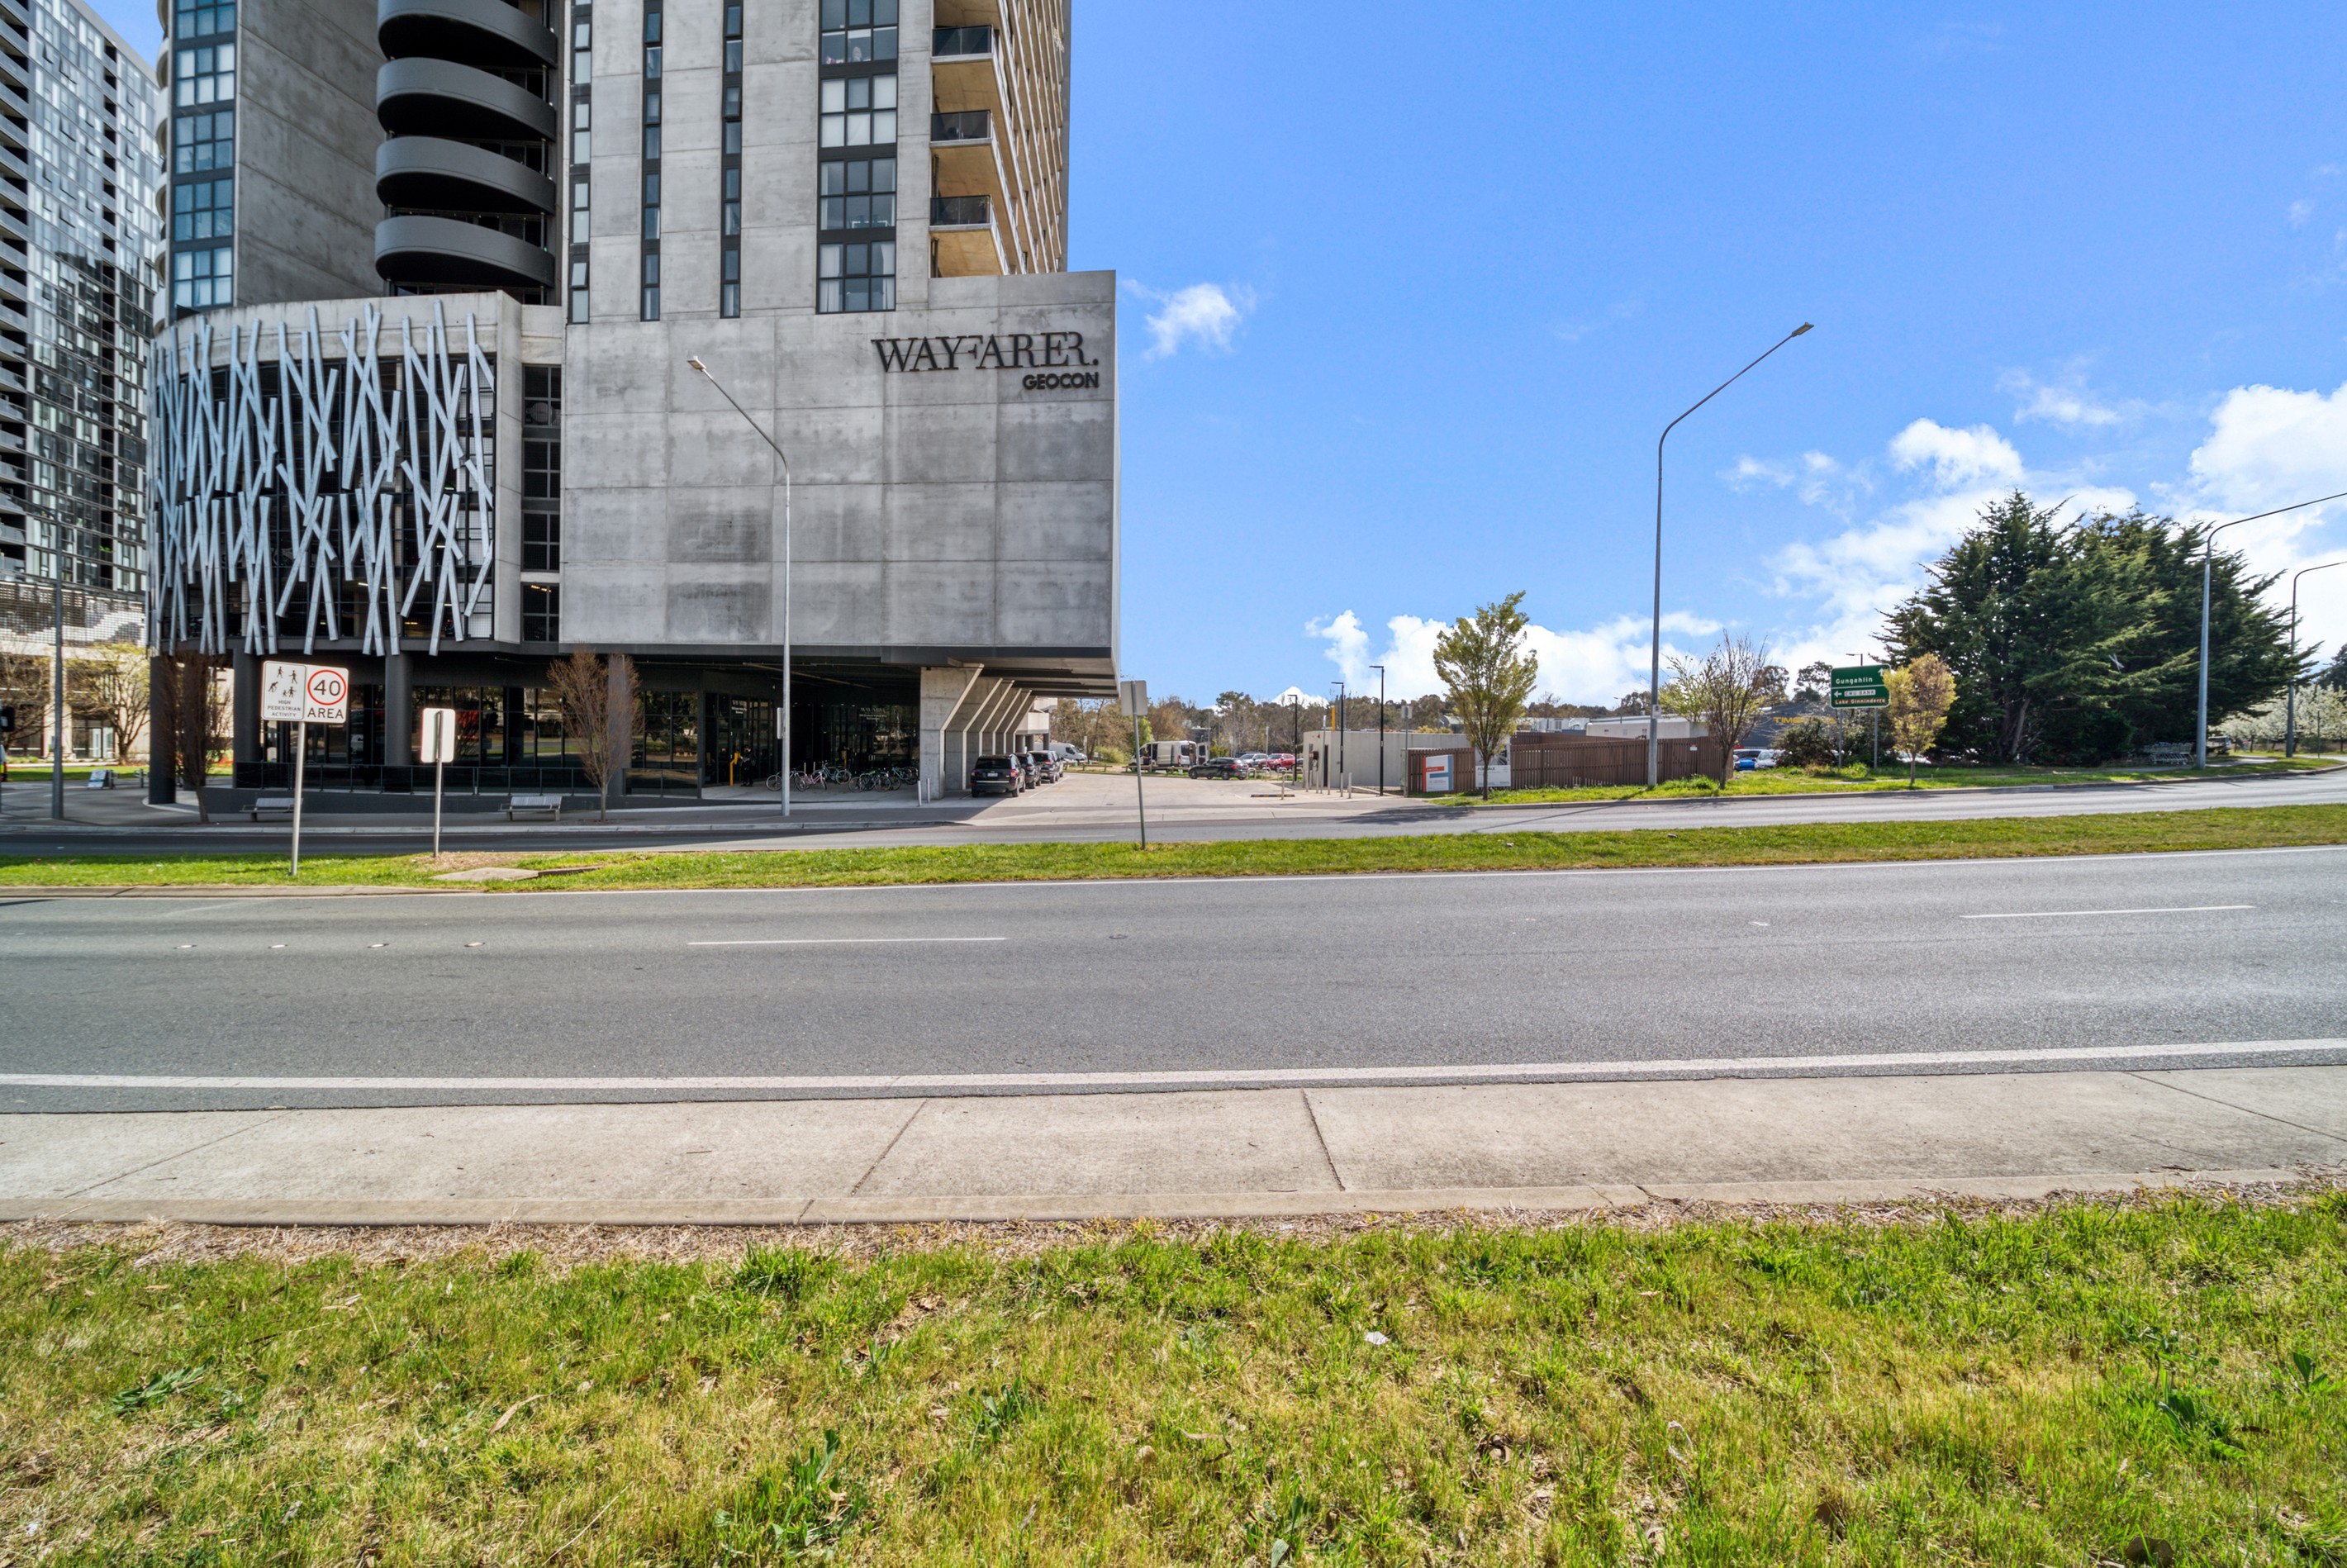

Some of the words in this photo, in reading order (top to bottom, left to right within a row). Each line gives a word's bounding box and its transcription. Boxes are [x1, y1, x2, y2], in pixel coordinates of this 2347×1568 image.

[1023, 372, 1100, 390] GEOCON
[313, 679, 341, 696] 40
[307, 707, 344, 720] AREA
